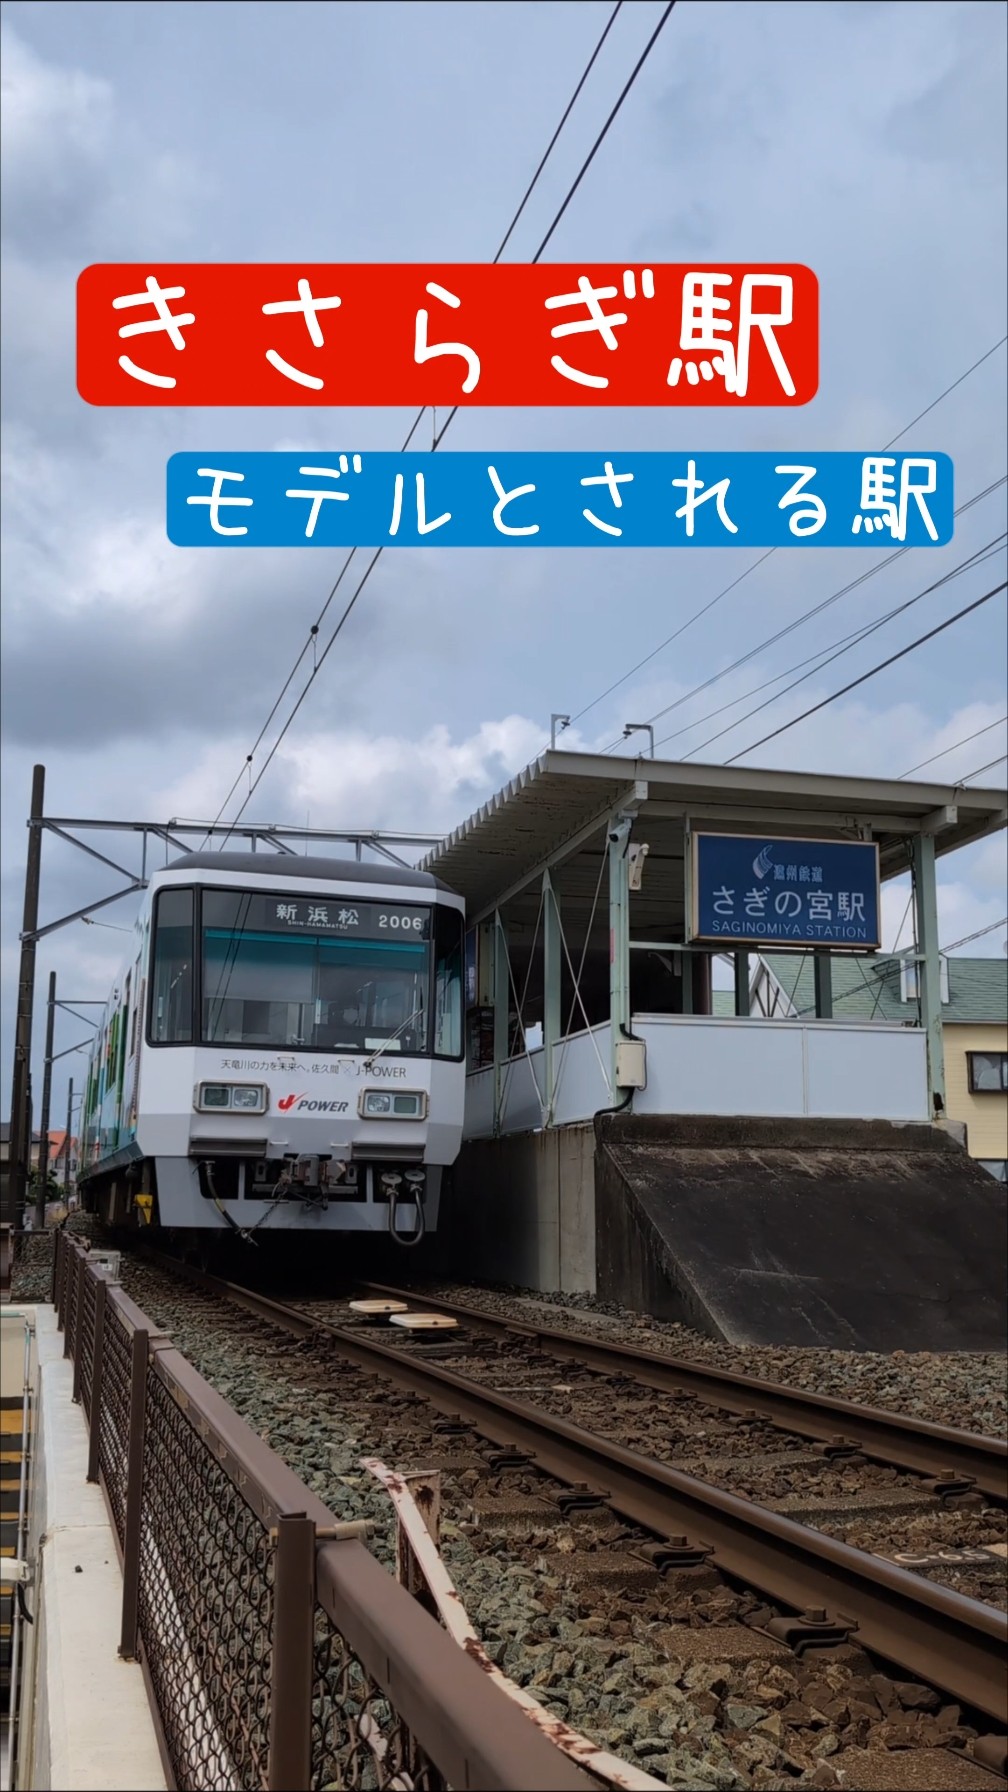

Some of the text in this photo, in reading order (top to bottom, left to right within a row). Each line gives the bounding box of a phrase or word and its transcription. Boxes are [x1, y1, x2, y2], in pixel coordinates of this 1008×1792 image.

[712, 885, 866, 922] さぎの宮駅
[276, 903, 359, 926] 新浜松
[378, 915, 422, 930] 2006
[712, 920, 867, 938] SAGINOMIYA STATION
[355, 1065, 406, 1078] J-POWER
